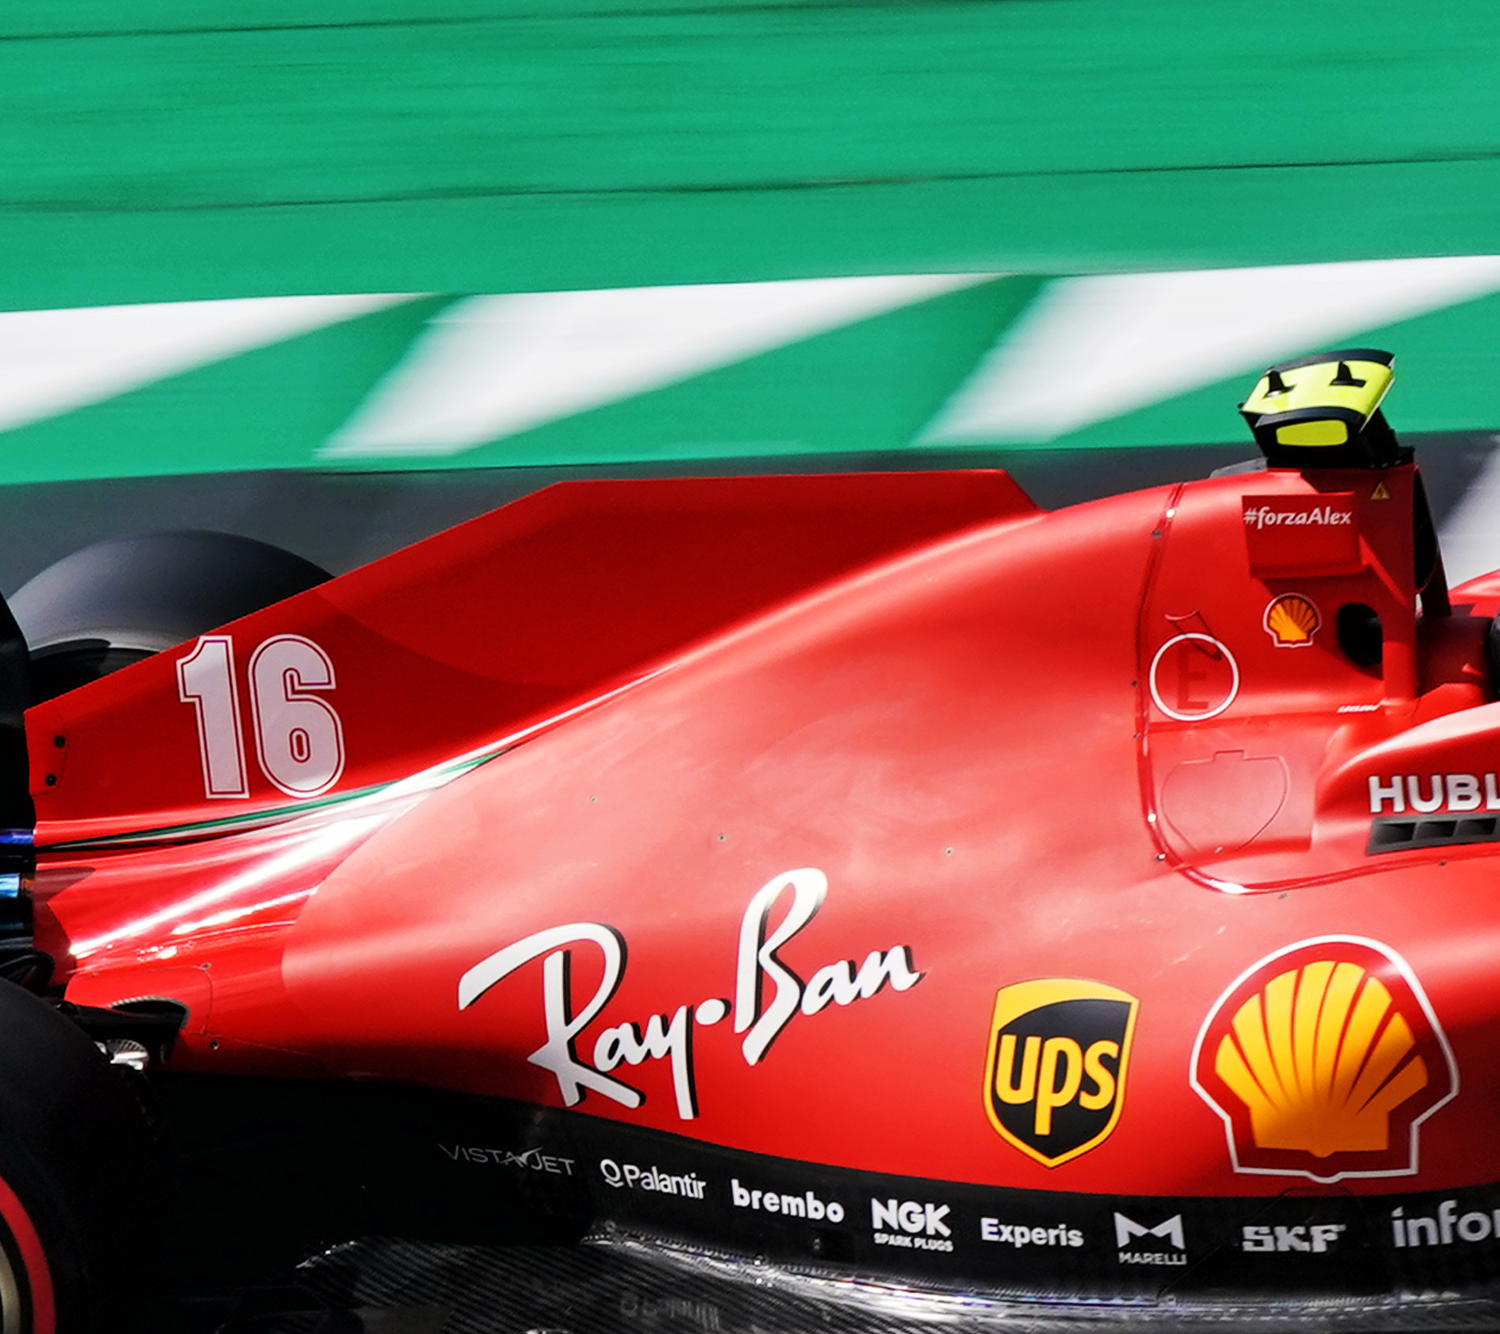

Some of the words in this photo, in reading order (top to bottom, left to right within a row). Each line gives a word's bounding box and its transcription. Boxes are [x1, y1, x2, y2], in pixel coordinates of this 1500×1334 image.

[1243, 506, 1352, 529] #forzaAlex
[175, 633, 345, 800] 16
[458, 867, 924, 1121] Ray-Ban
[994, 1036, 1119, 1135] ups
[622, 1164, 707, 1199] Palantir
[731, 1179, 844, 1223] brembo
[871, 1197, 952, 1238] NGK
[874, 1232, 912, 1249] SPARK
[914, 1236, 954, 1252] PLUGS
[980, 1216, 1085, 1249] Experis
[1242, 1224, 1341, 1253] SKF
[1118, 1251, 1187, 1266] MARELLI
